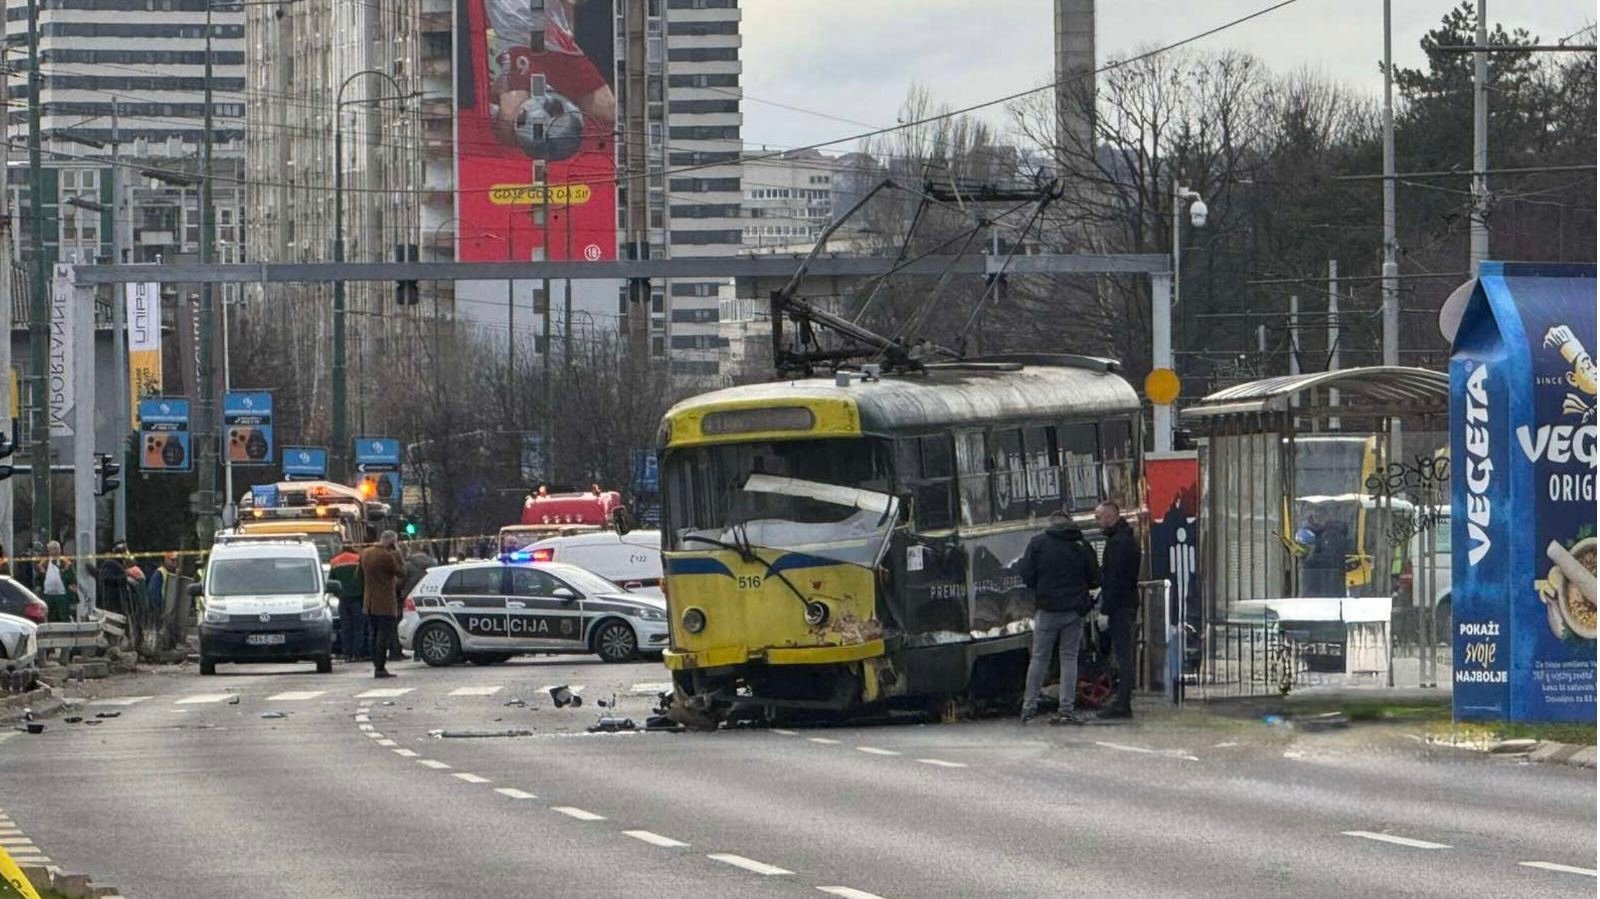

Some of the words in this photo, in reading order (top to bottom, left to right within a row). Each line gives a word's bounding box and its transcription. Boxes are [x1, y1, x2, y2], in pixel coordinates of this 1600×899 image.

[516, 55, 529, 76] 9
[1536, 375, 1563, 385] SINCE
[1516, 424, 1597, 469] VEG
[1466, 363, 1494, 566] VEGETA
[738, 575, 761, 589] 516
[930, 583, 967, 599] PREMIU
[468, 617, 550, 633] POLICIJA
[1460, 620, 1500, 636] POKAŽI
[1464, 636, 1497, 669] svoje
[1455, 670, 1508, 683] NAJBOLJE
